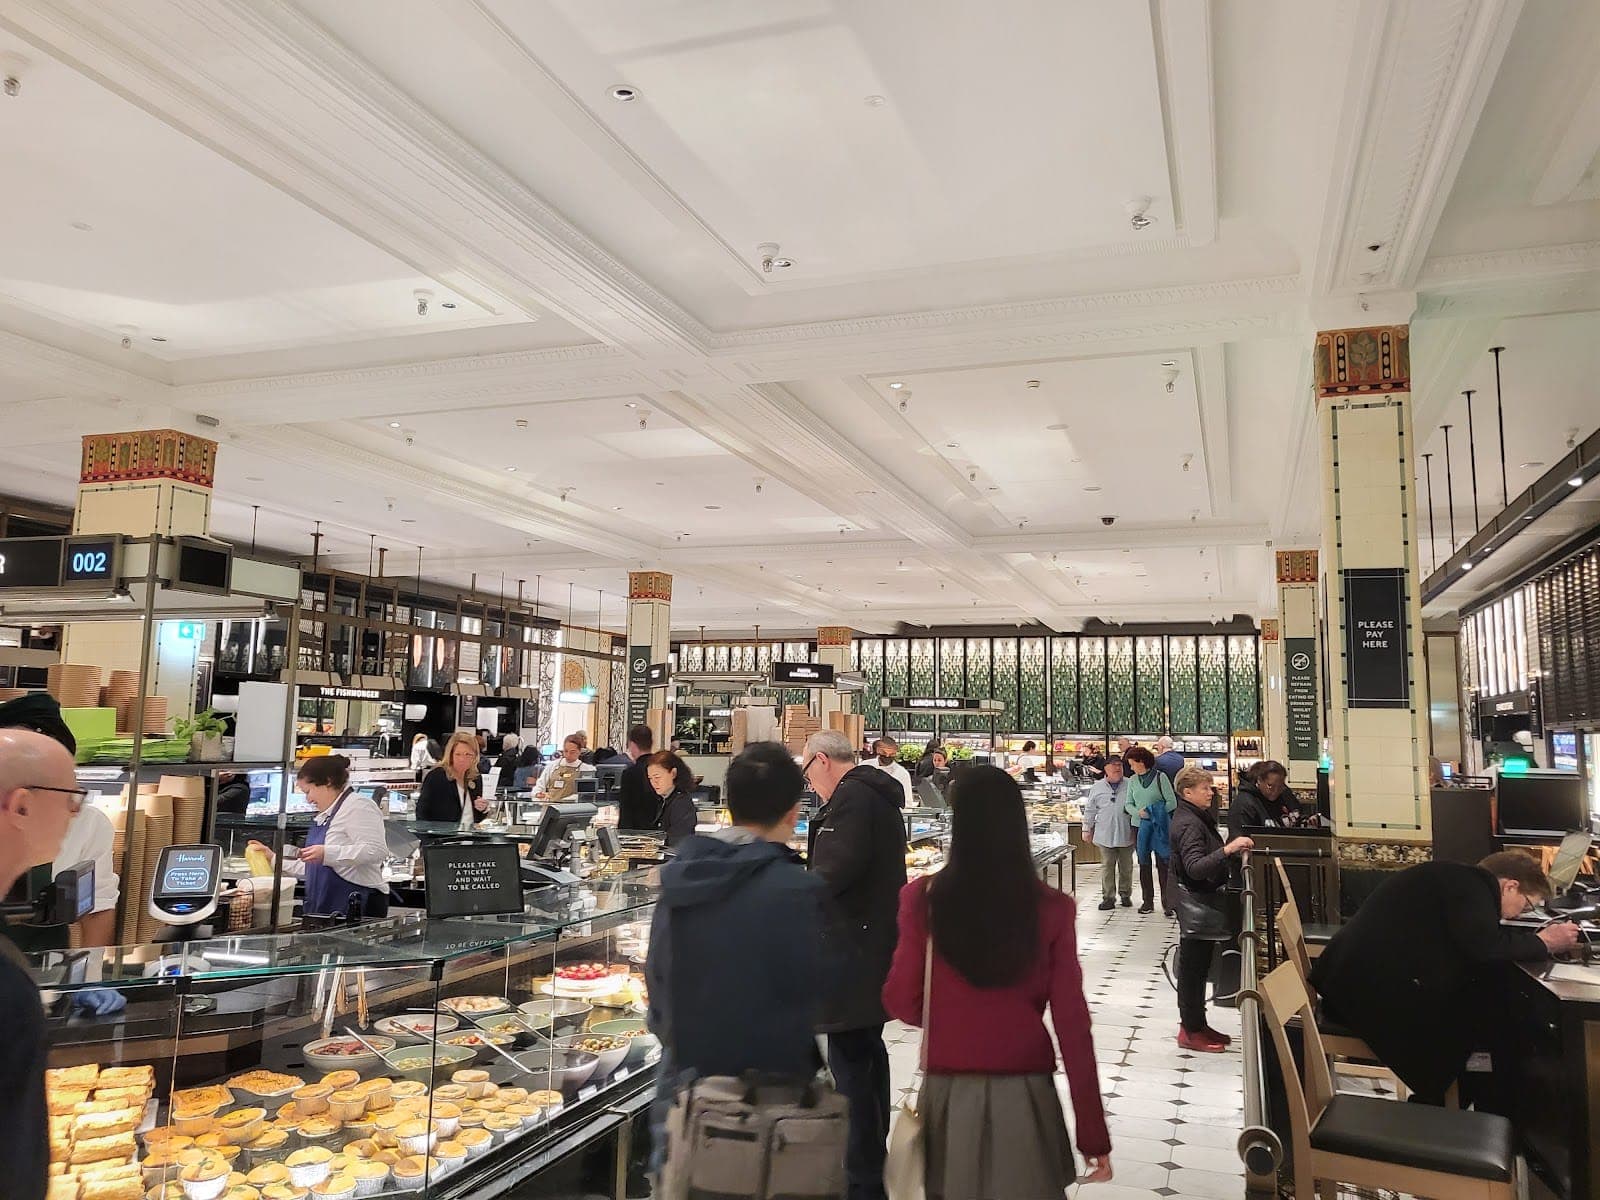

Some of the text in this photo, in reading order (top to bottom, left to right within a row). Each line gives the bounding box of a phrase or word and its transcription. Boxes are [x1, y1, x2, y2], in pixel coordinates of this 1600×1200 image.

[73, 552, 106, 572] 002
[1358, 621, 1394, 629] PLEASE
[1366, 630, 1384, 638] PAY
[1362, 640, 1389, 648] HERE
[320, 687, 335, 696] THE
